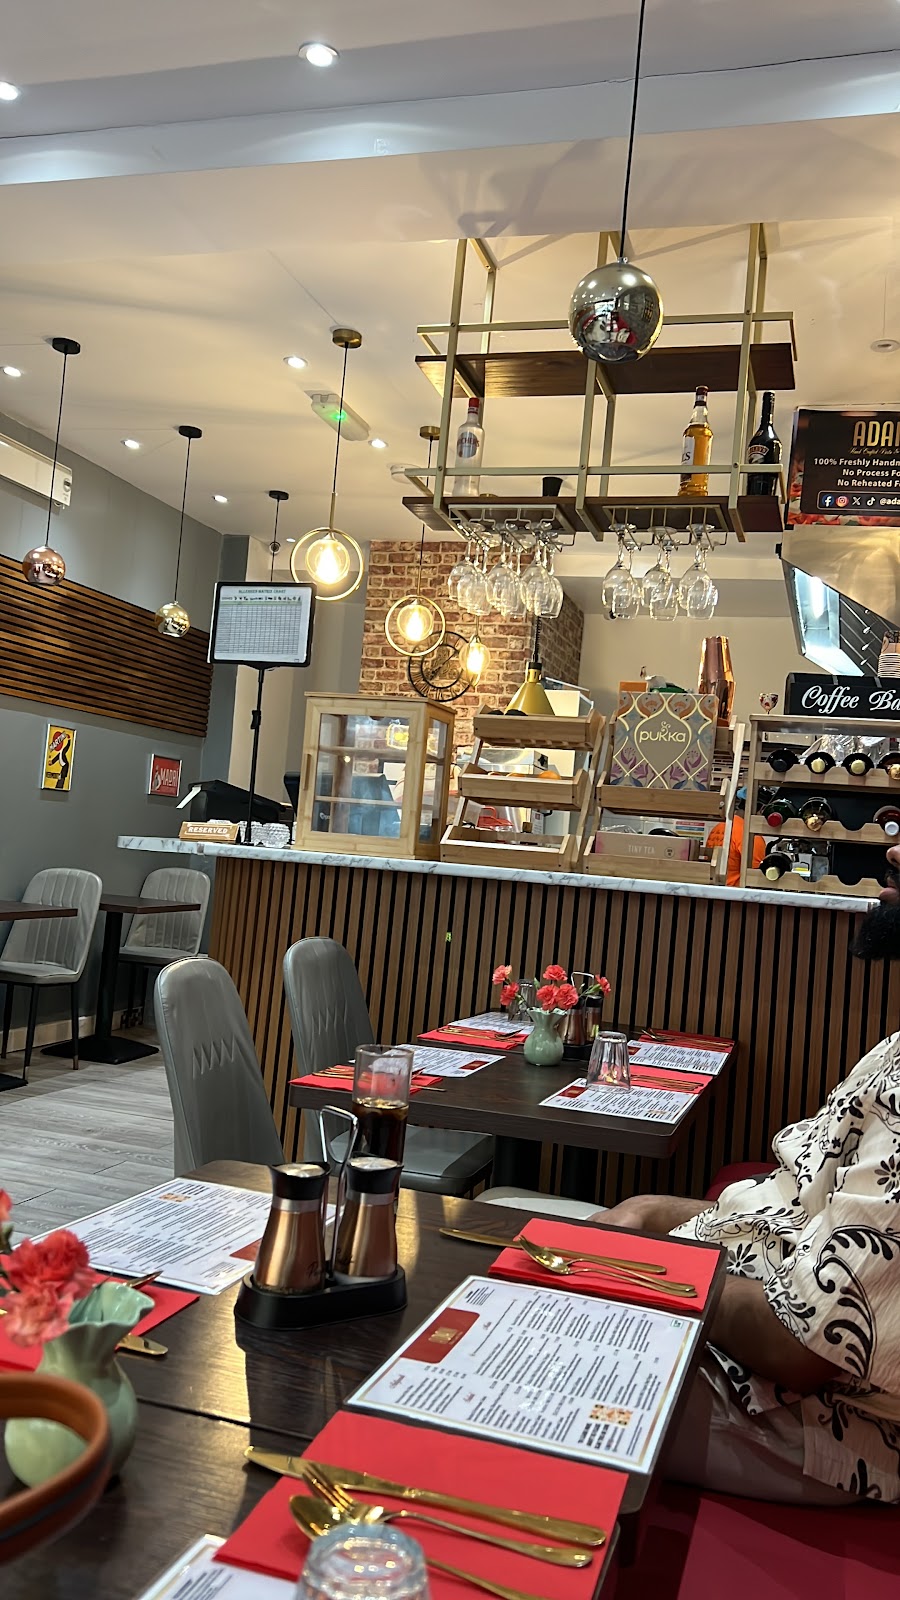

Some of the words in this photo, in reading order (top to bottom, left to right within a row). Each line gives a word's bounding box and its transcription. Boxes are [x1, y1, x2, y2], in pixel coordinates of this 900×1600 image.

[813, 457, 838, 466] 100%
[839, 458, 871, 468] Freshly
[842, 468, 855, 476] No
[856, 468, 890, 477] Process
[837, 478, 850, 486] No
[851, 479, 893, 487] Reheated
[801, 685, 860, 714] Coffee
[639, 726, 686, 743] pukka
[187, 826, 229, 834] RESERVED
[628, 844, 643, 853] TINY
[644, 845, 655, 855] TEA
